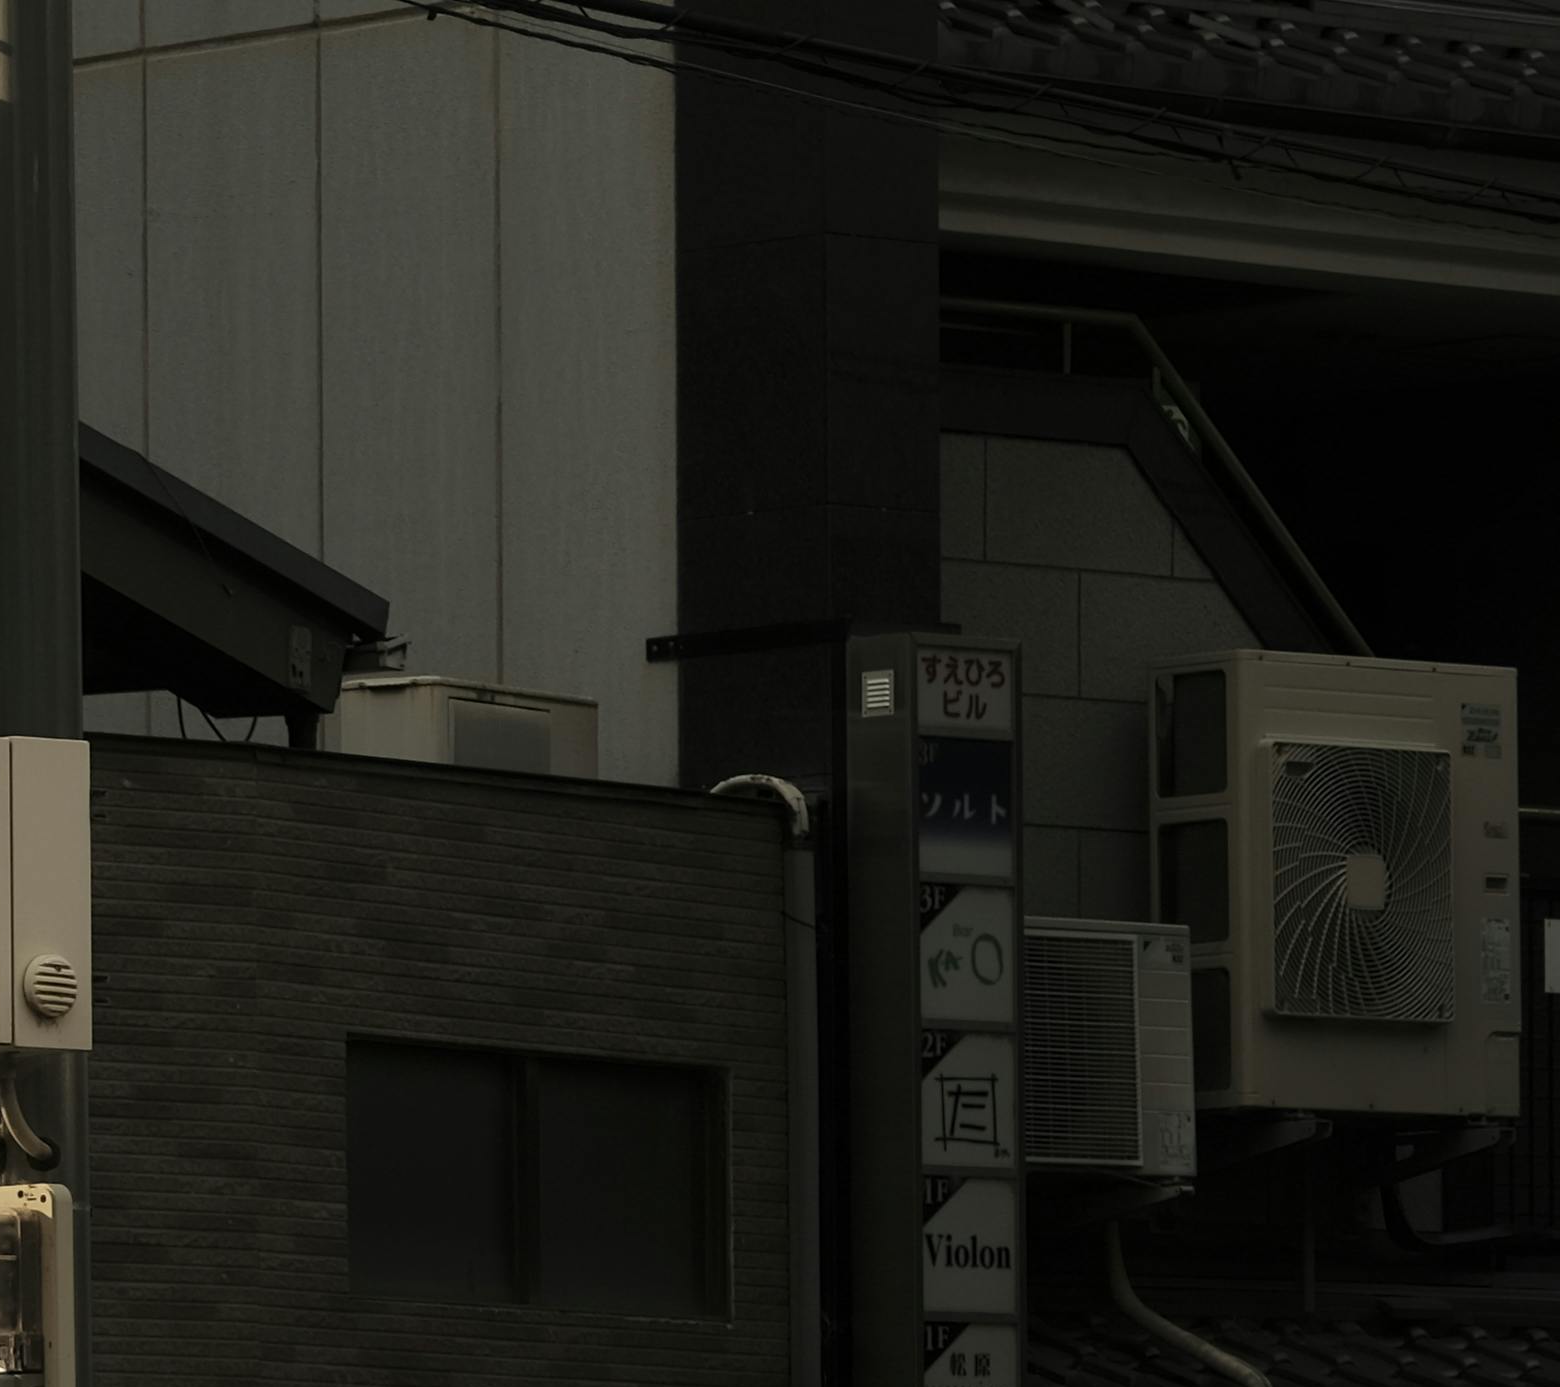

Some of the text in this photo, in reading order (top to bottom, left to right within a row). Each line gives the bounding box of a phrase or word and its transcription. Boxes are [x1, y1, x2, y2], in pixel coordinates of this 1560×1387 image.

[921, 655, 1005, 688] すえひろ
[943, 690, 987, 720] ビル
[921, 792, 1007, 825] ソルト
[920, 885, 946, 913] 3F
[921, 1033, 950, 1058] 2F
[925, 1234, 1011, 1269] Violon
[925, 1325, 951, 1351] 1F
